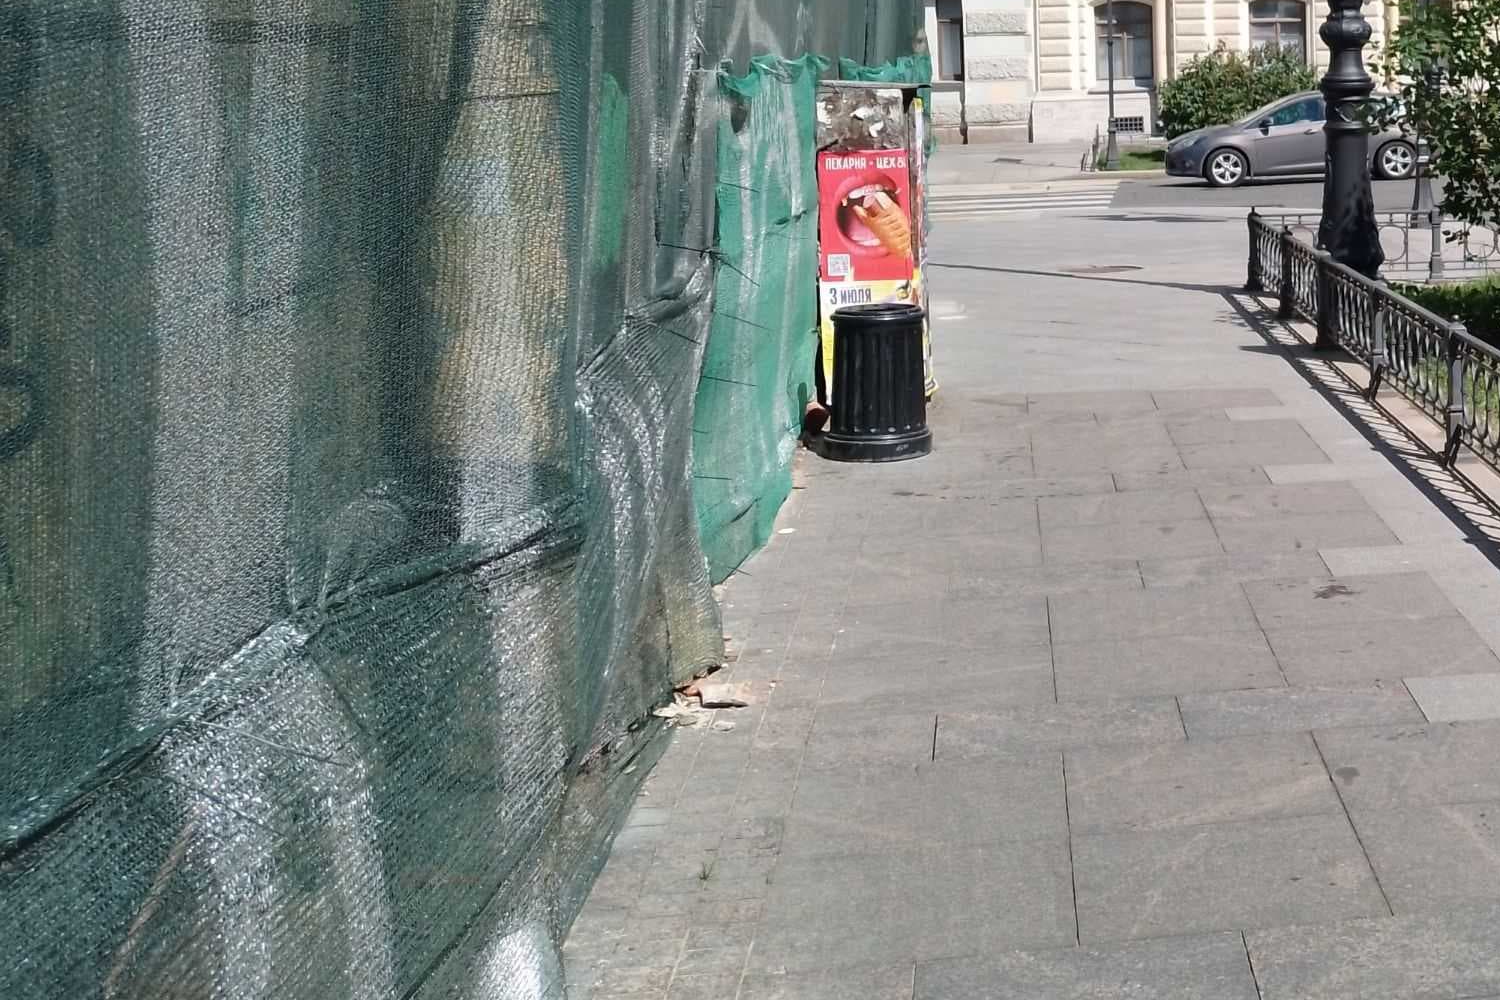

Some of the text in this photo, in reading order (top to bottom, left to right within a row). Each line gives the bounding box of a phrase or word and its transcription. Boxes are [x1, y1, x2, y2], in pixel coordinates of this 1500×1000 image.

[825, 156, 867, 171] ПЕКАРНЯ
[829, 287, 872, 305] 3 ИЮЛЯ
